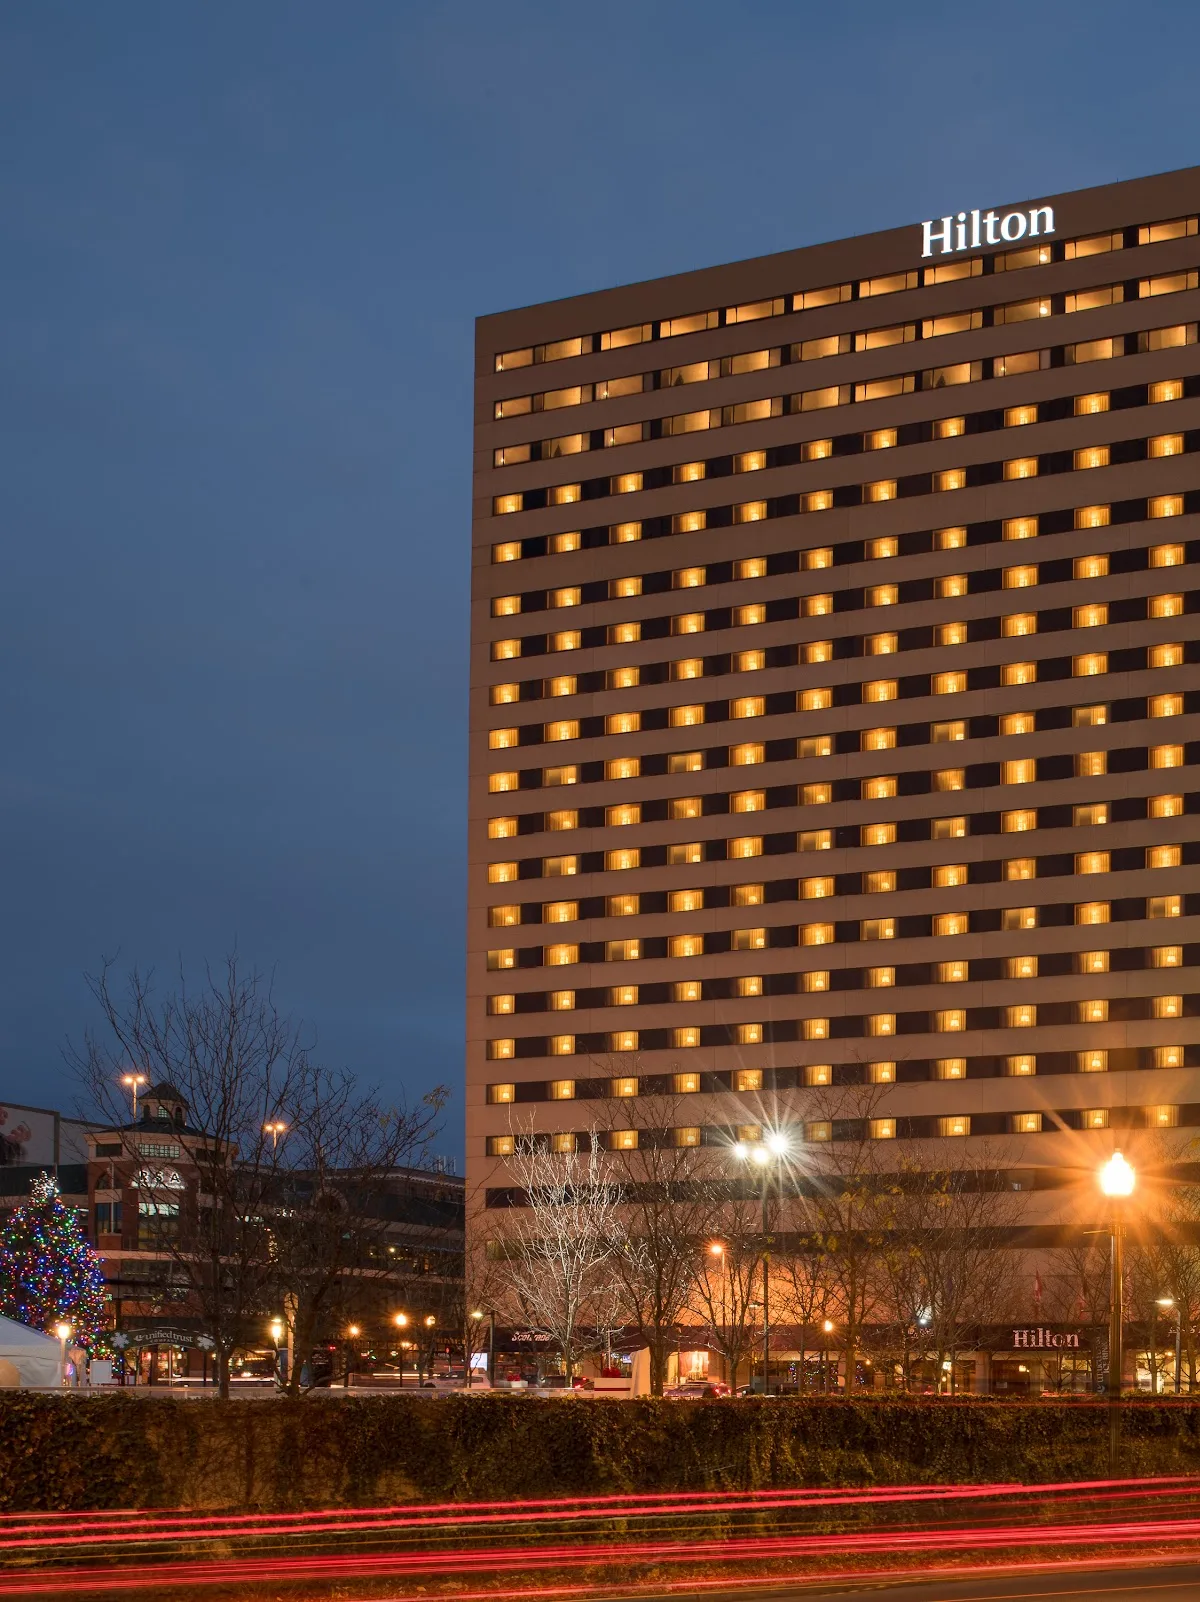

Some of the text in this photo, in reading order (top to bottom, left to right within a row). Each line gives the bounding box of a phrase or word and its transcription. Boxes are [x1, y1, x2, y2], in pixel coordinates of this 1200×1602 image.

[921, 206, 1055, 258] Hilton
[145, 1330, 193, 1343] unified trust
[1012, 1327, 1080, 1348] Hilton
